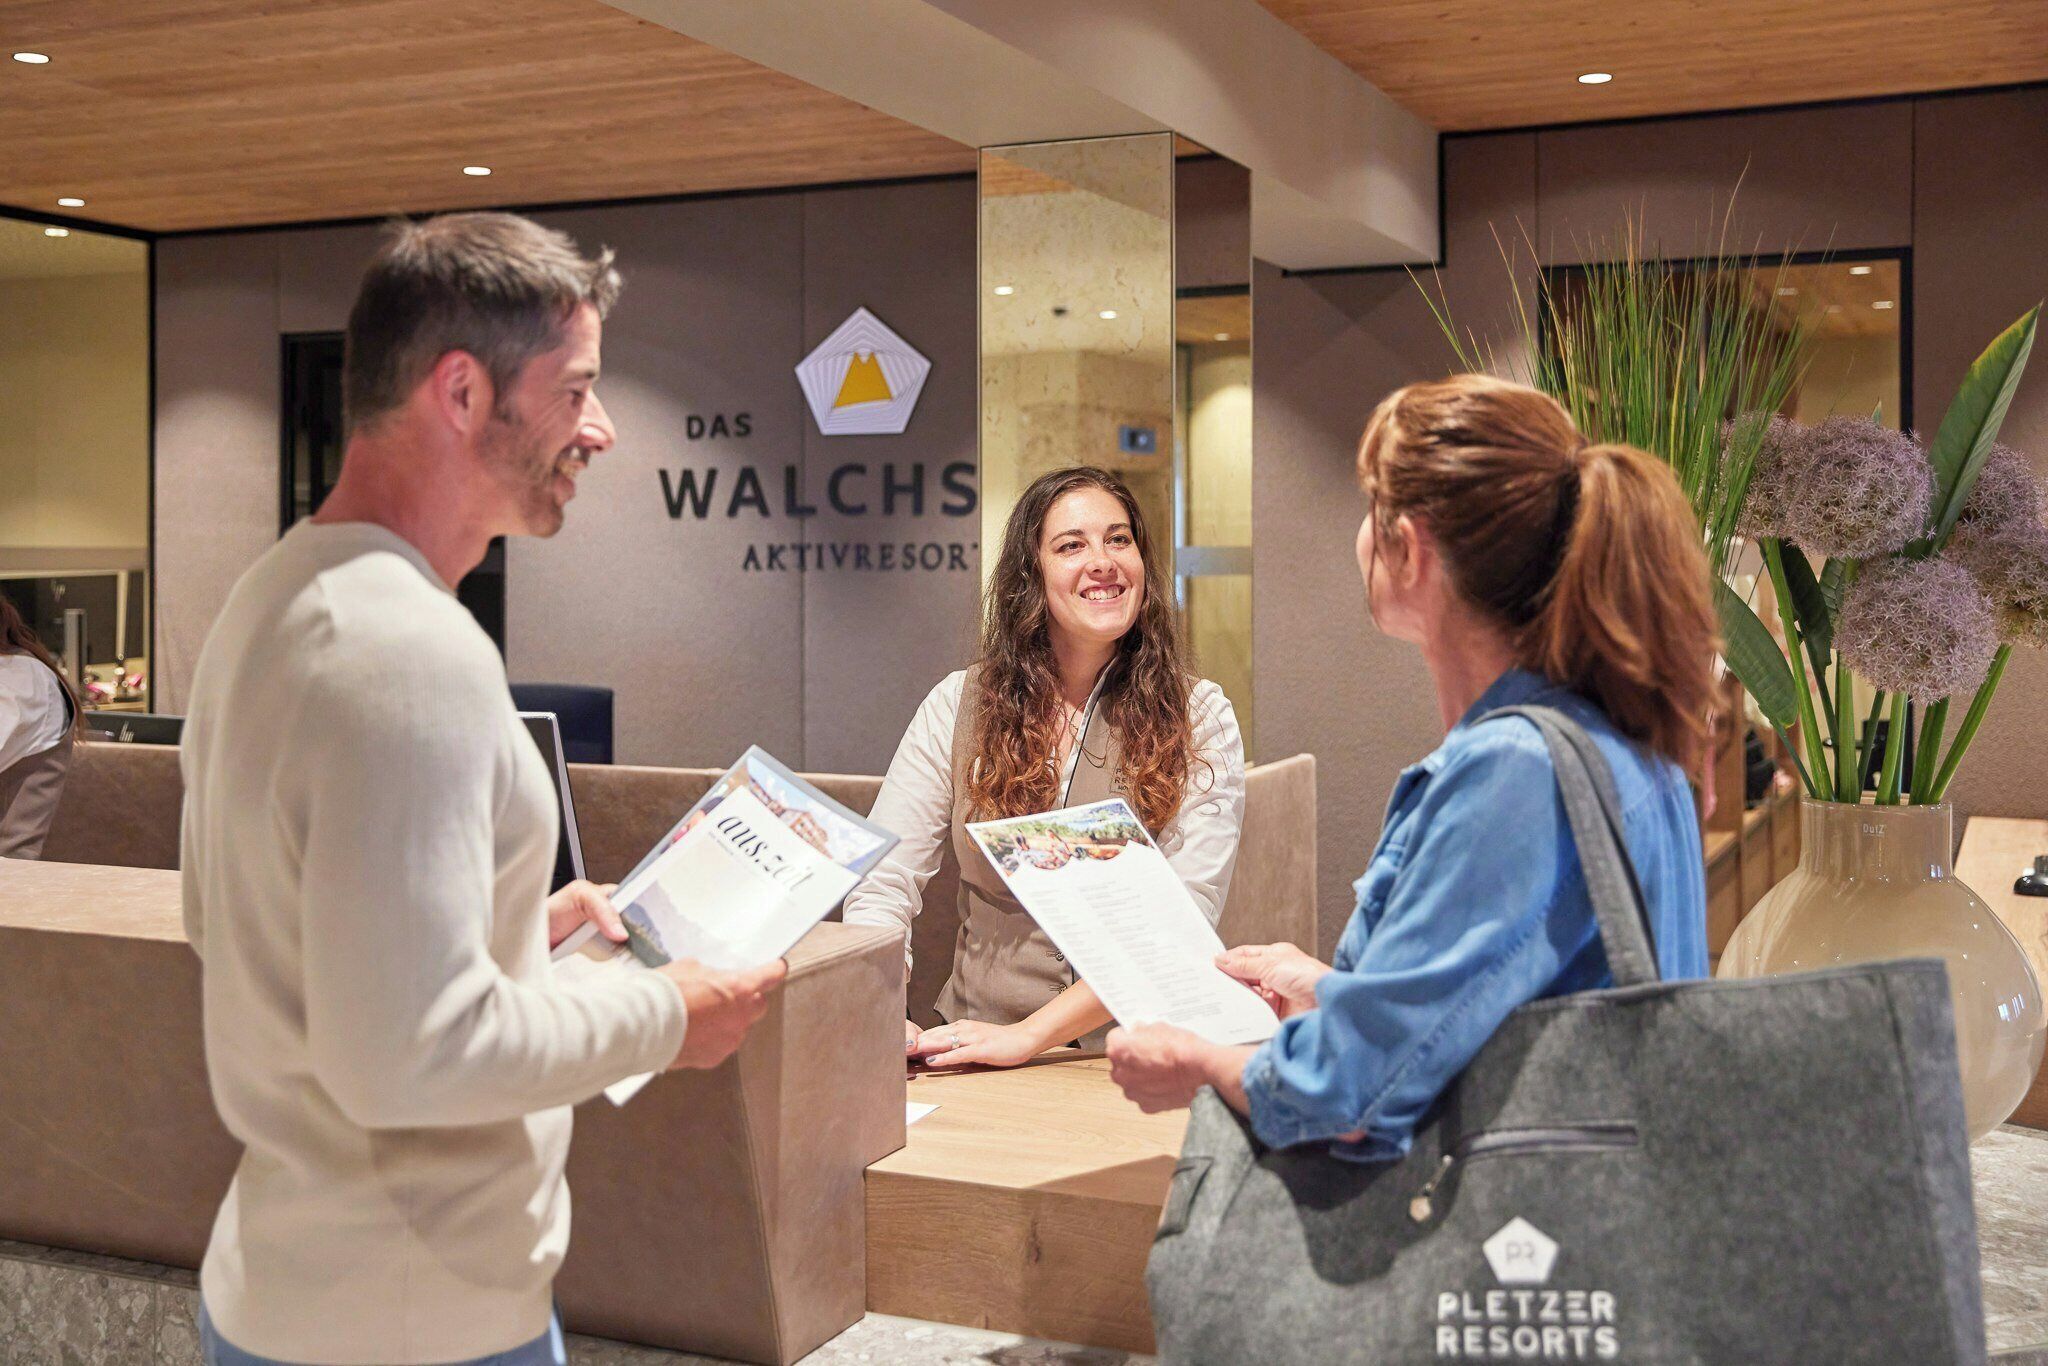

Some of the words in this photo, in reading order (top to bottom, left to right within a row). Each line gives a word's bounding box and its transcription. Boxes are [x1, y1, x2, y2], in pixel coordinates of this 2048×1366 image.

[685, 413, 753, 440] DAS
[658, 462, 978, 519] WALCHS
[1437, 1289, 1617, 1323] PLETZER
[1436, 1325, 1620, 1359] RESORTS
